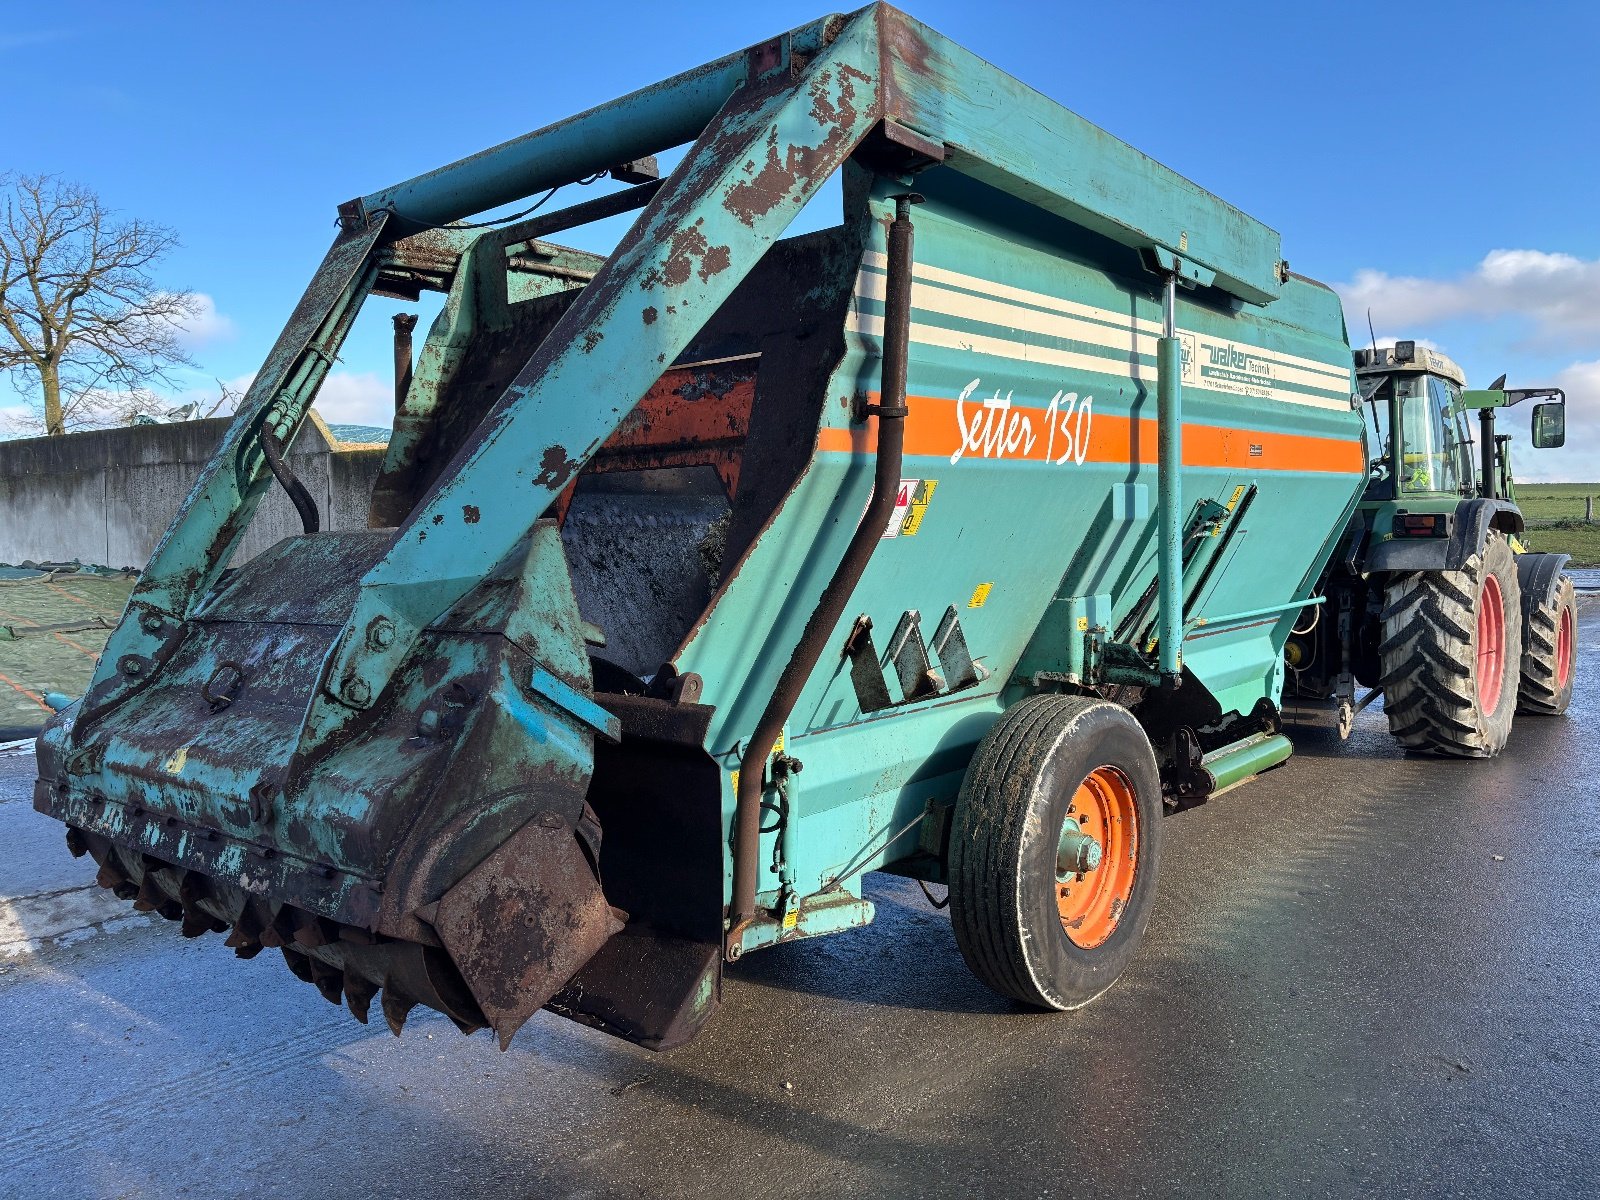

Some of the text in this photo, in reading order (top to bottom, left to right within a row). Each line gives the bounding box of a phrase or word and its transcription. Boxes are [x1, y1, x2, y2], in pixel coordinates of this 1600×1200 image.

[1248, 360, 1270, 375] Technik
[950, 378, 1092, 466] Setter 130
